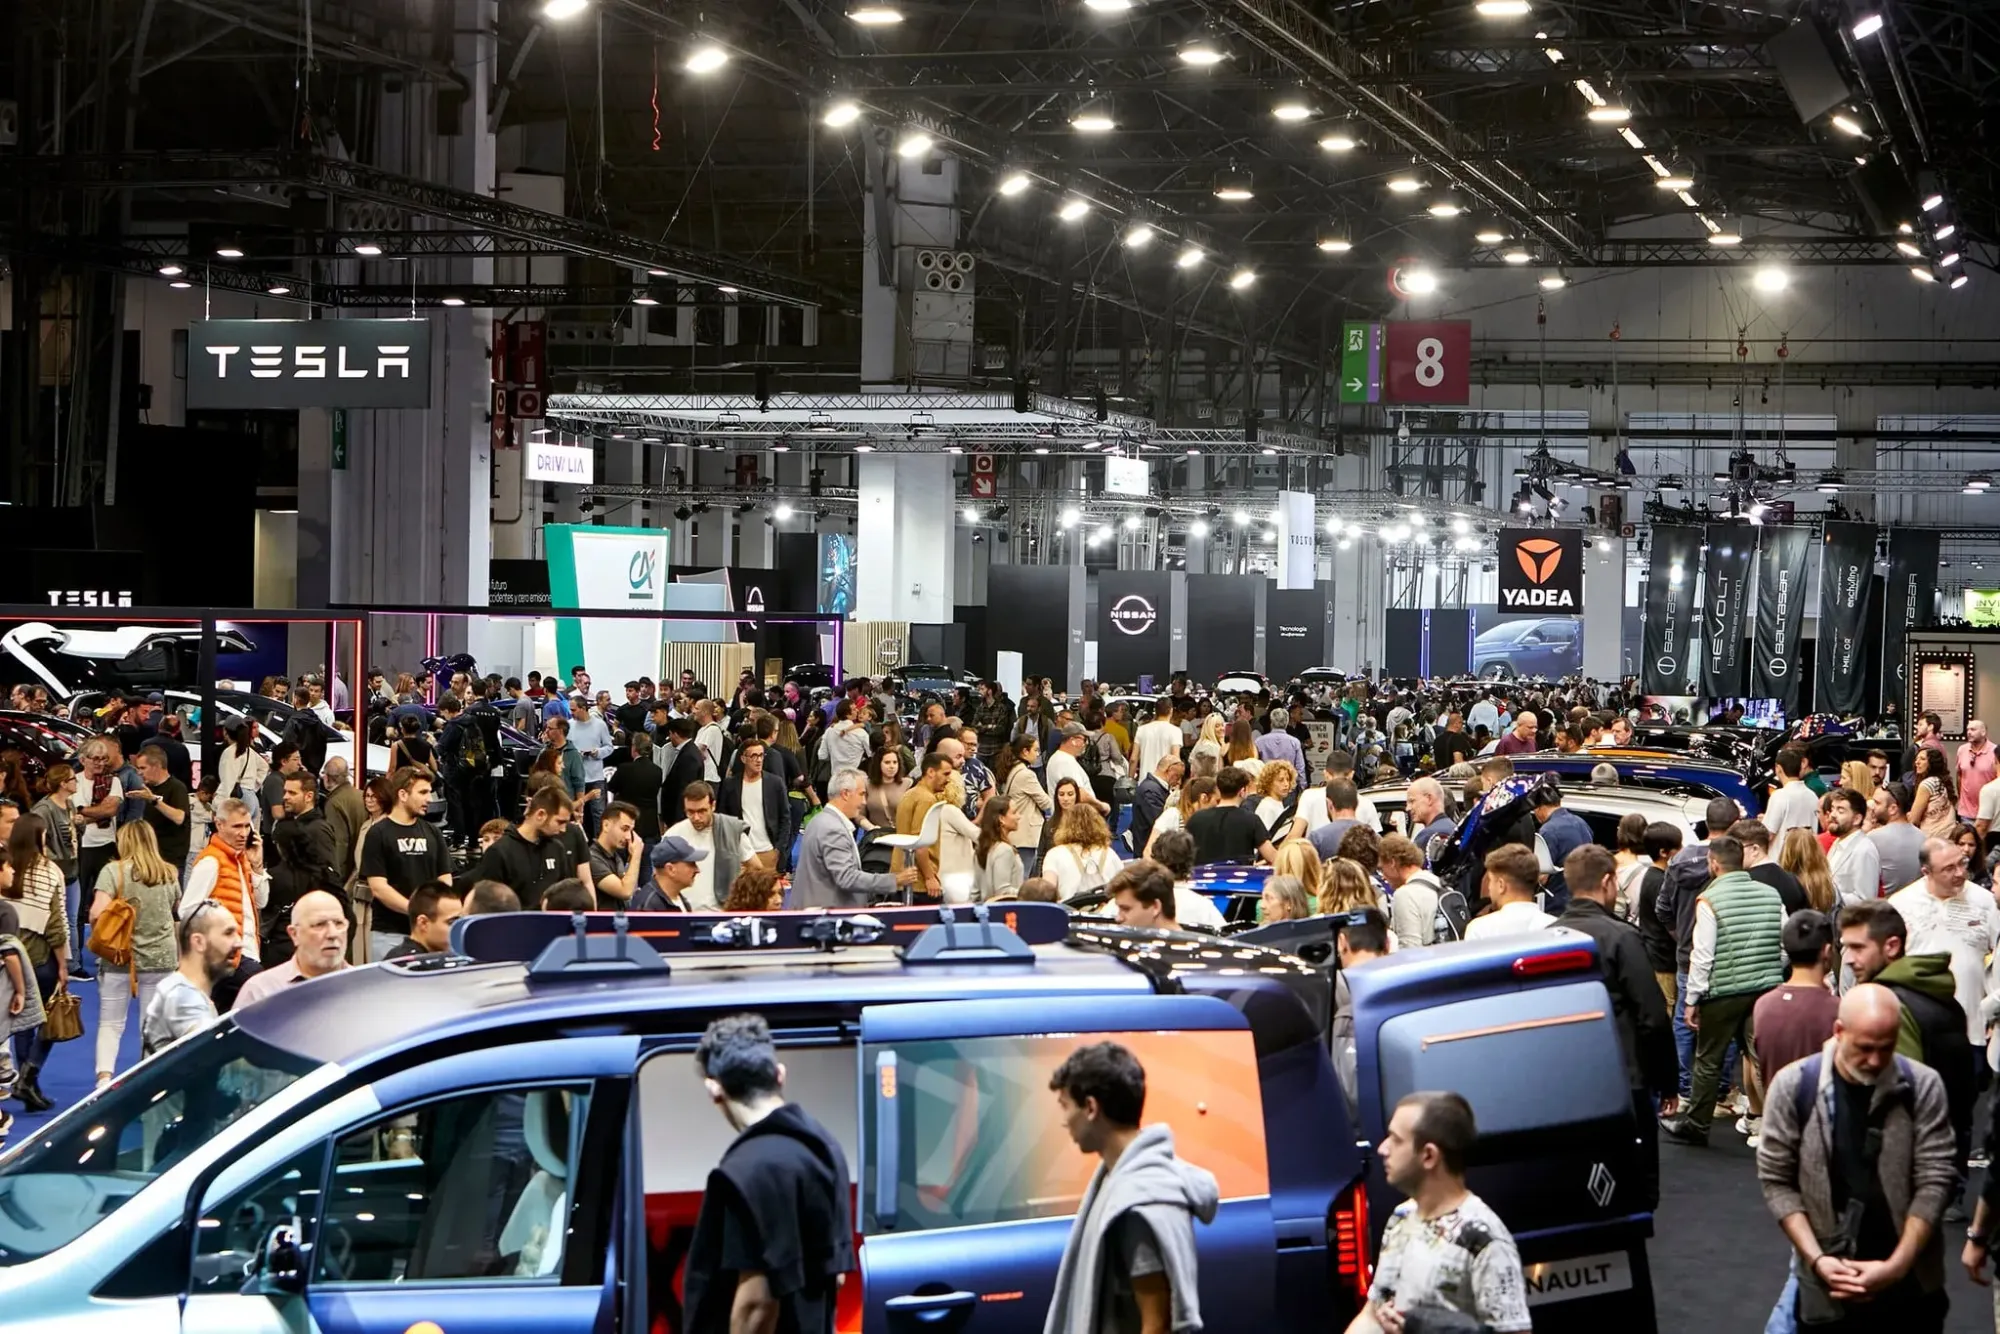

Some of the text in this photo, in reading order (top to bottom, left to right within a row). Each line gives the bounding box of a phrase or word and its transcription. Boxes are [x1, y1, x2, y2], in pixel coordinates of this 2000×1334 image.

[205, 345, 410, 378] TESLA
[1415, 337, 1444, 387] 8
[47, 590, 132, 607] TESLA
[489, 592, 514, 603] ccidentes
[530, 592, 552, 603] emisione
[1502, 588, 1554, 607] YADEA
[1905, 573, 1918, 627] TASAR
[1110, 610, 1156, 619] NISSAN
[1663, 590, 1677, 653] BALTAS
[1712, 569, 1729, 675] REVOLT
[1526, 1262, 1612, 1296] NAULT
